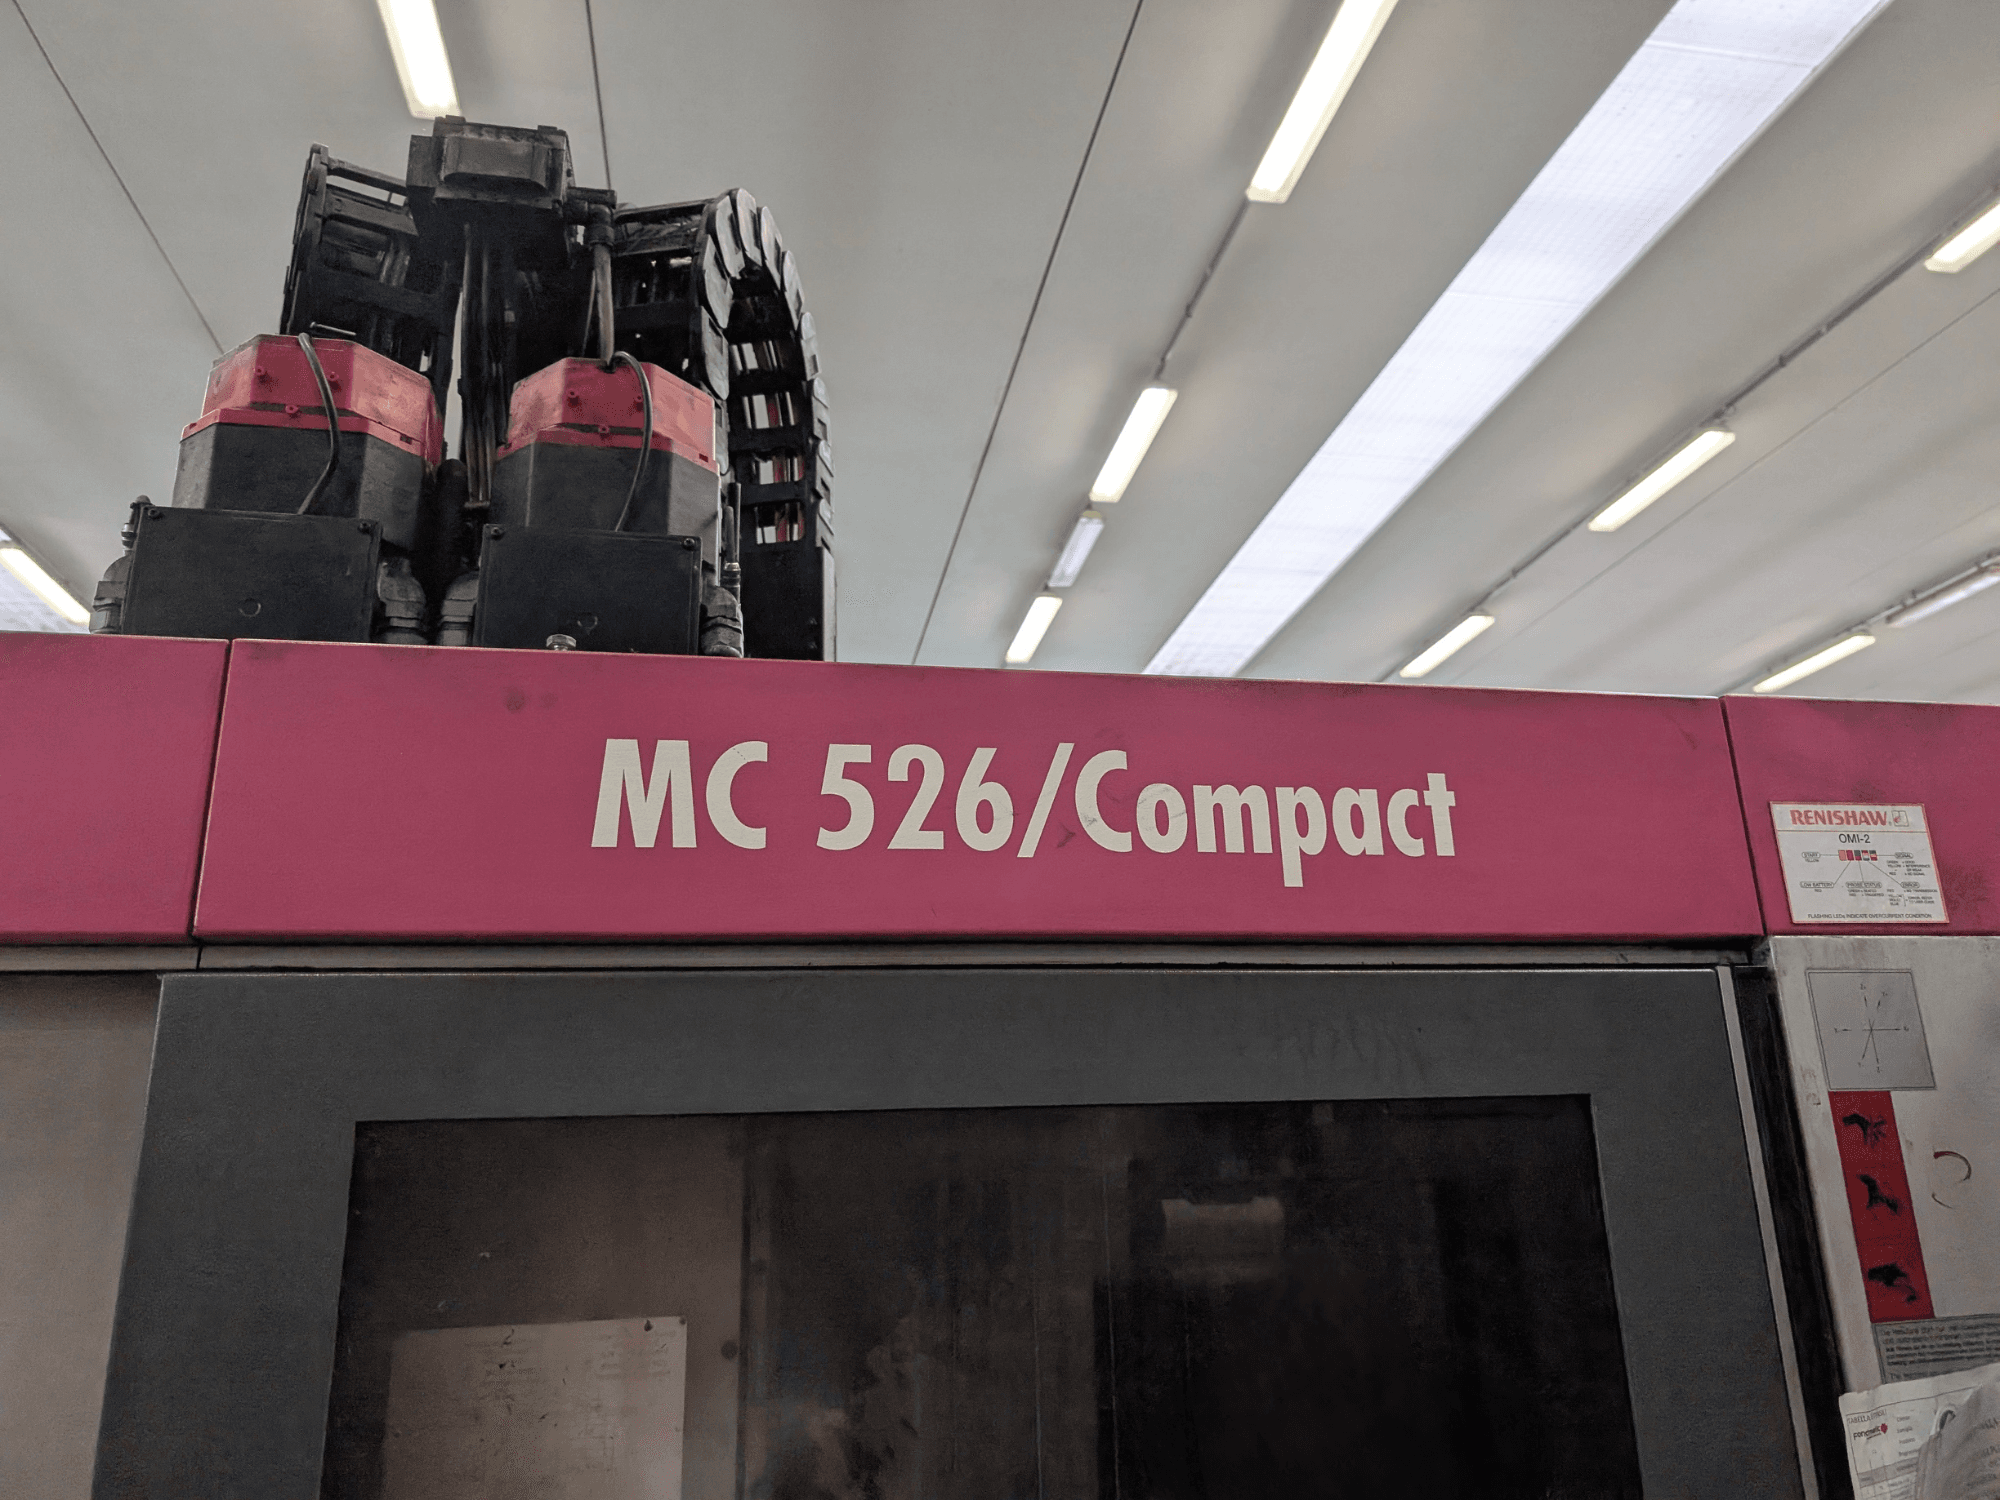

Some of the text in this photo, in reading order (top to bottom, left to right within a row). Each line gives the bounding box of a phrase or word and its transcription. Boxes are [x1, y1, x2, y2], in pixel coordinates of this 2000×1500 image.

[592, 739, 1456, 888] MC 526/Compact
[1790, 809, 1887, 826] RENISHAW
[1838, 833, 1871, 844] OMI-2
